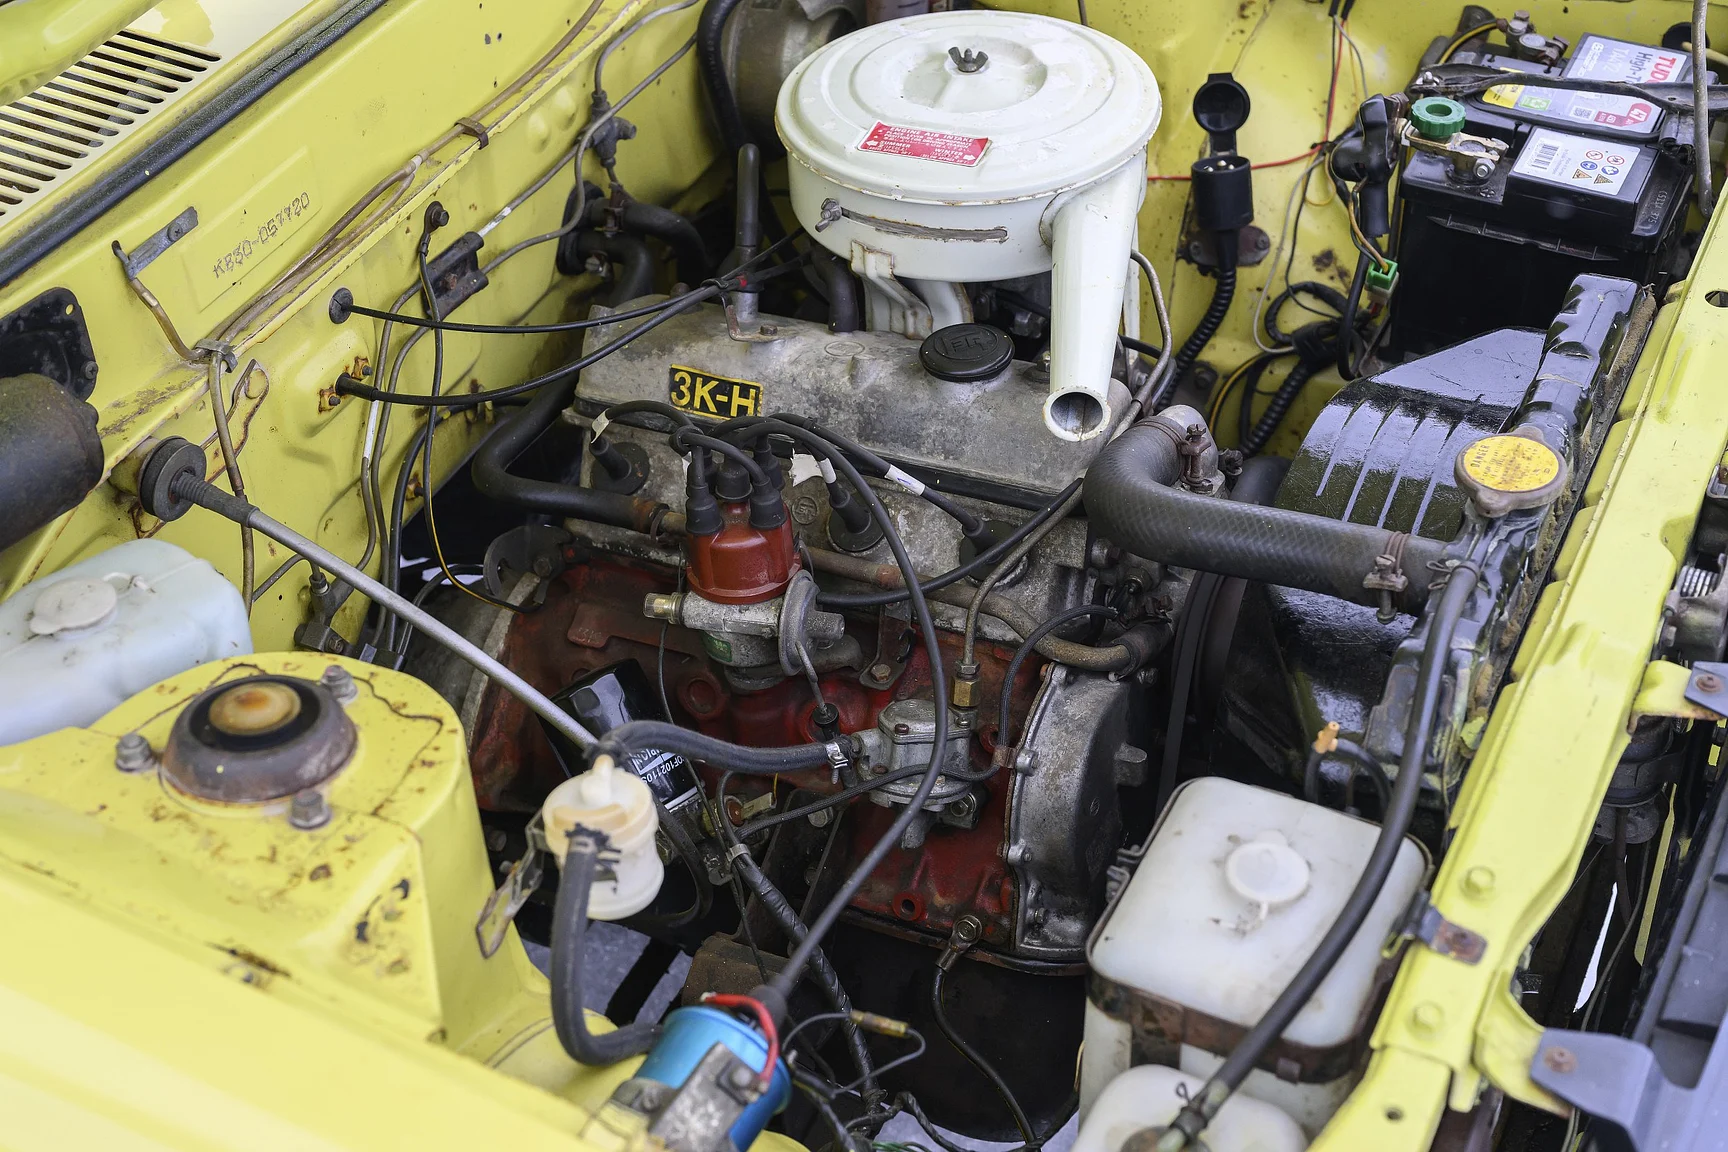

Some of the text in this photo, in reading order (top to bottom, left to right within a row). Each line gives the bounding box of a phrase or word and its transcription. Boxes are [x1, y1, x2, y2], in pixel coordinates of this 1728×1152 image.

[1646, 56, 1676, 83] TUD
[880, 140, 911, 148] SUMMER
[889, 127, 920, 135] ENGINE
[943, 134, 973, 143] INTAKE
[934, 148, 963, 156] WINTER
[670, 371, 757, 418] 3K-H
[1470, 444, 1490, 468] DANGER
[640, 755, 685, 784] OF102110S
